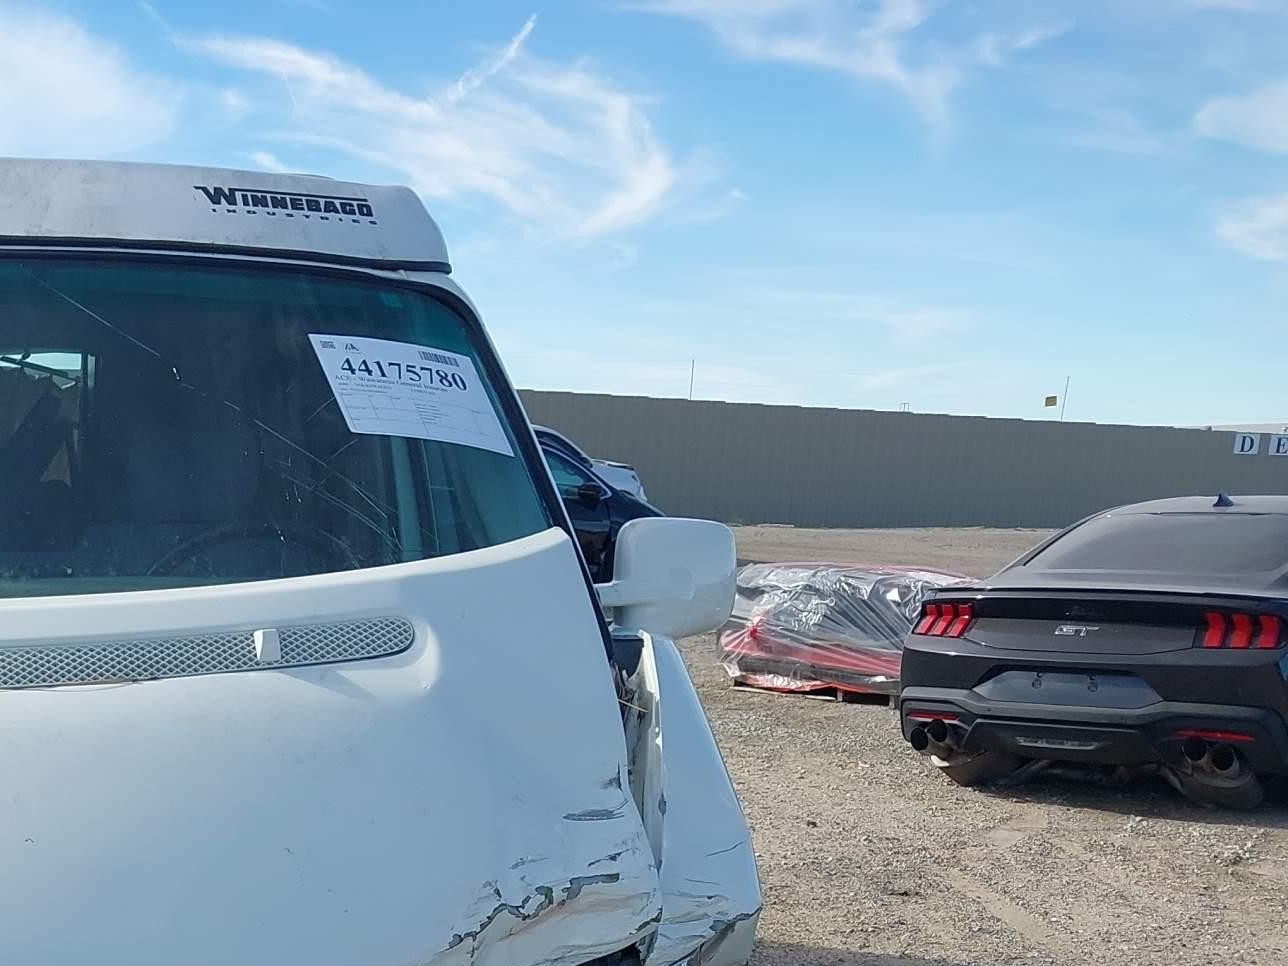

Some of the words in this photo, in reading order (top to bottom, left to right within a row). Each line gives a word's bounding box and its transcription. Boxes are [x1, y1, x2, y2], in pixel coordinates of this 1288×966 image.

[194, 186, 374, 217] WINNEBAGO
[212, 208, 379, 225] INDUSTRIES
[341, 357, 468, 391] 44175780
[1054, 624, 1100, 637] GT
